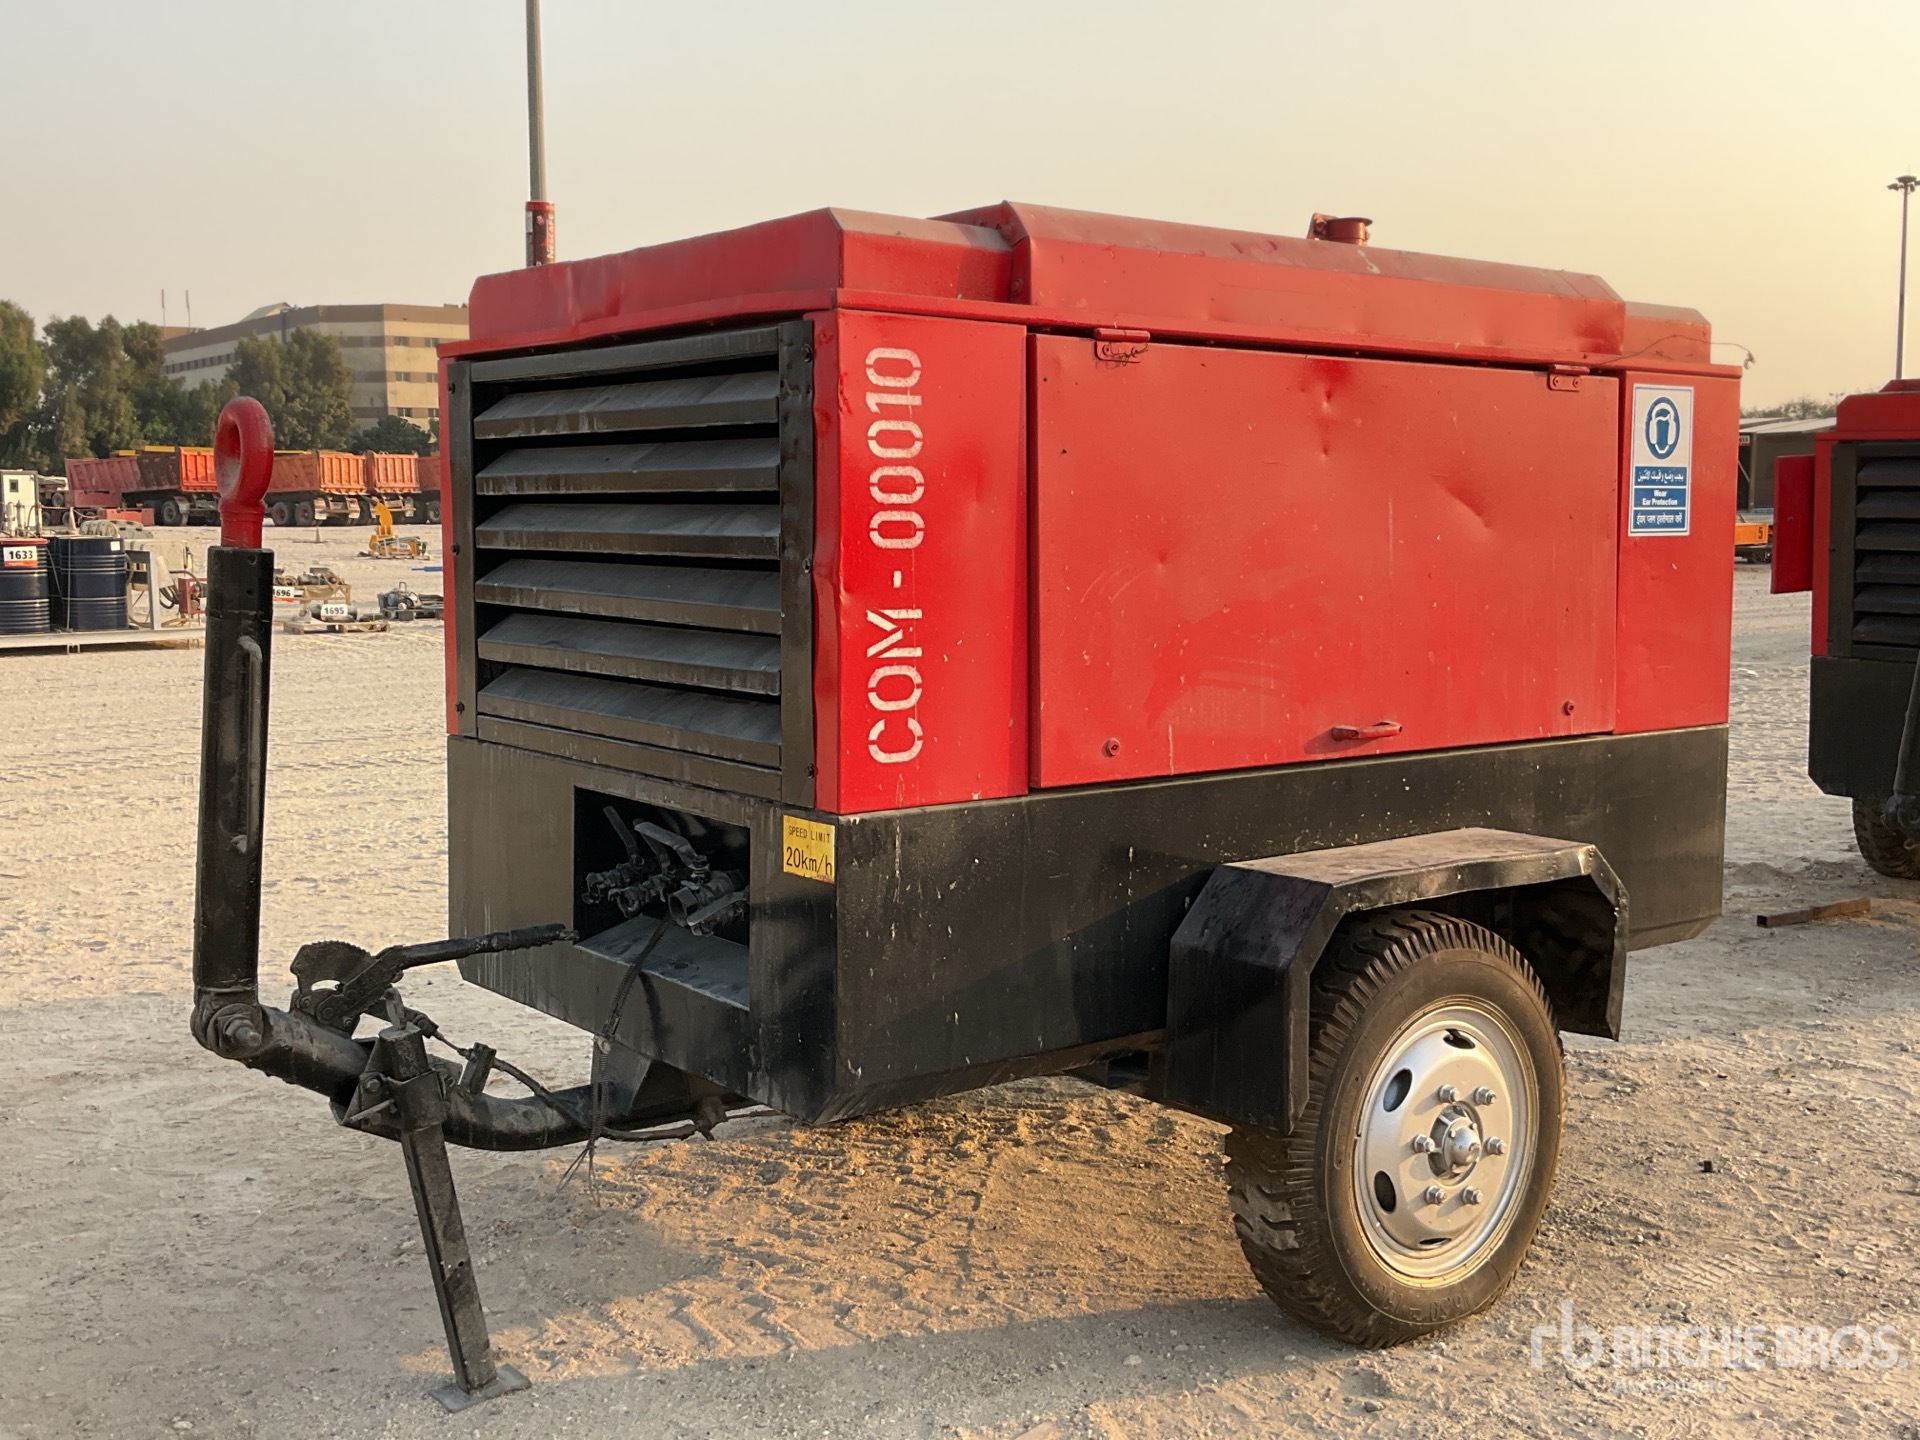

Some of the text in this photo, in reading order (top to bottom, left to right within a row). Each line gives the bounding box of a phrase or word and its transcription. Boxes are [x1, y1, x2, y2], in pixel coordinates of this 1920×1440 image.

[865, 347, 925, 549] 00010
[1653, 489, 1667, 497] Wear
[1642, 498, 1678, 506] Ear Protection
[1758, 526, 1764, 540] 5
[9, 550, 34, 560] 1633
[324, 607, 345, 615] 1695
[867, 608, 924, 763] COM
[788, 825, 831, 843] SPEED LIMIT
[786, 846, 833, 877] 20km/h
